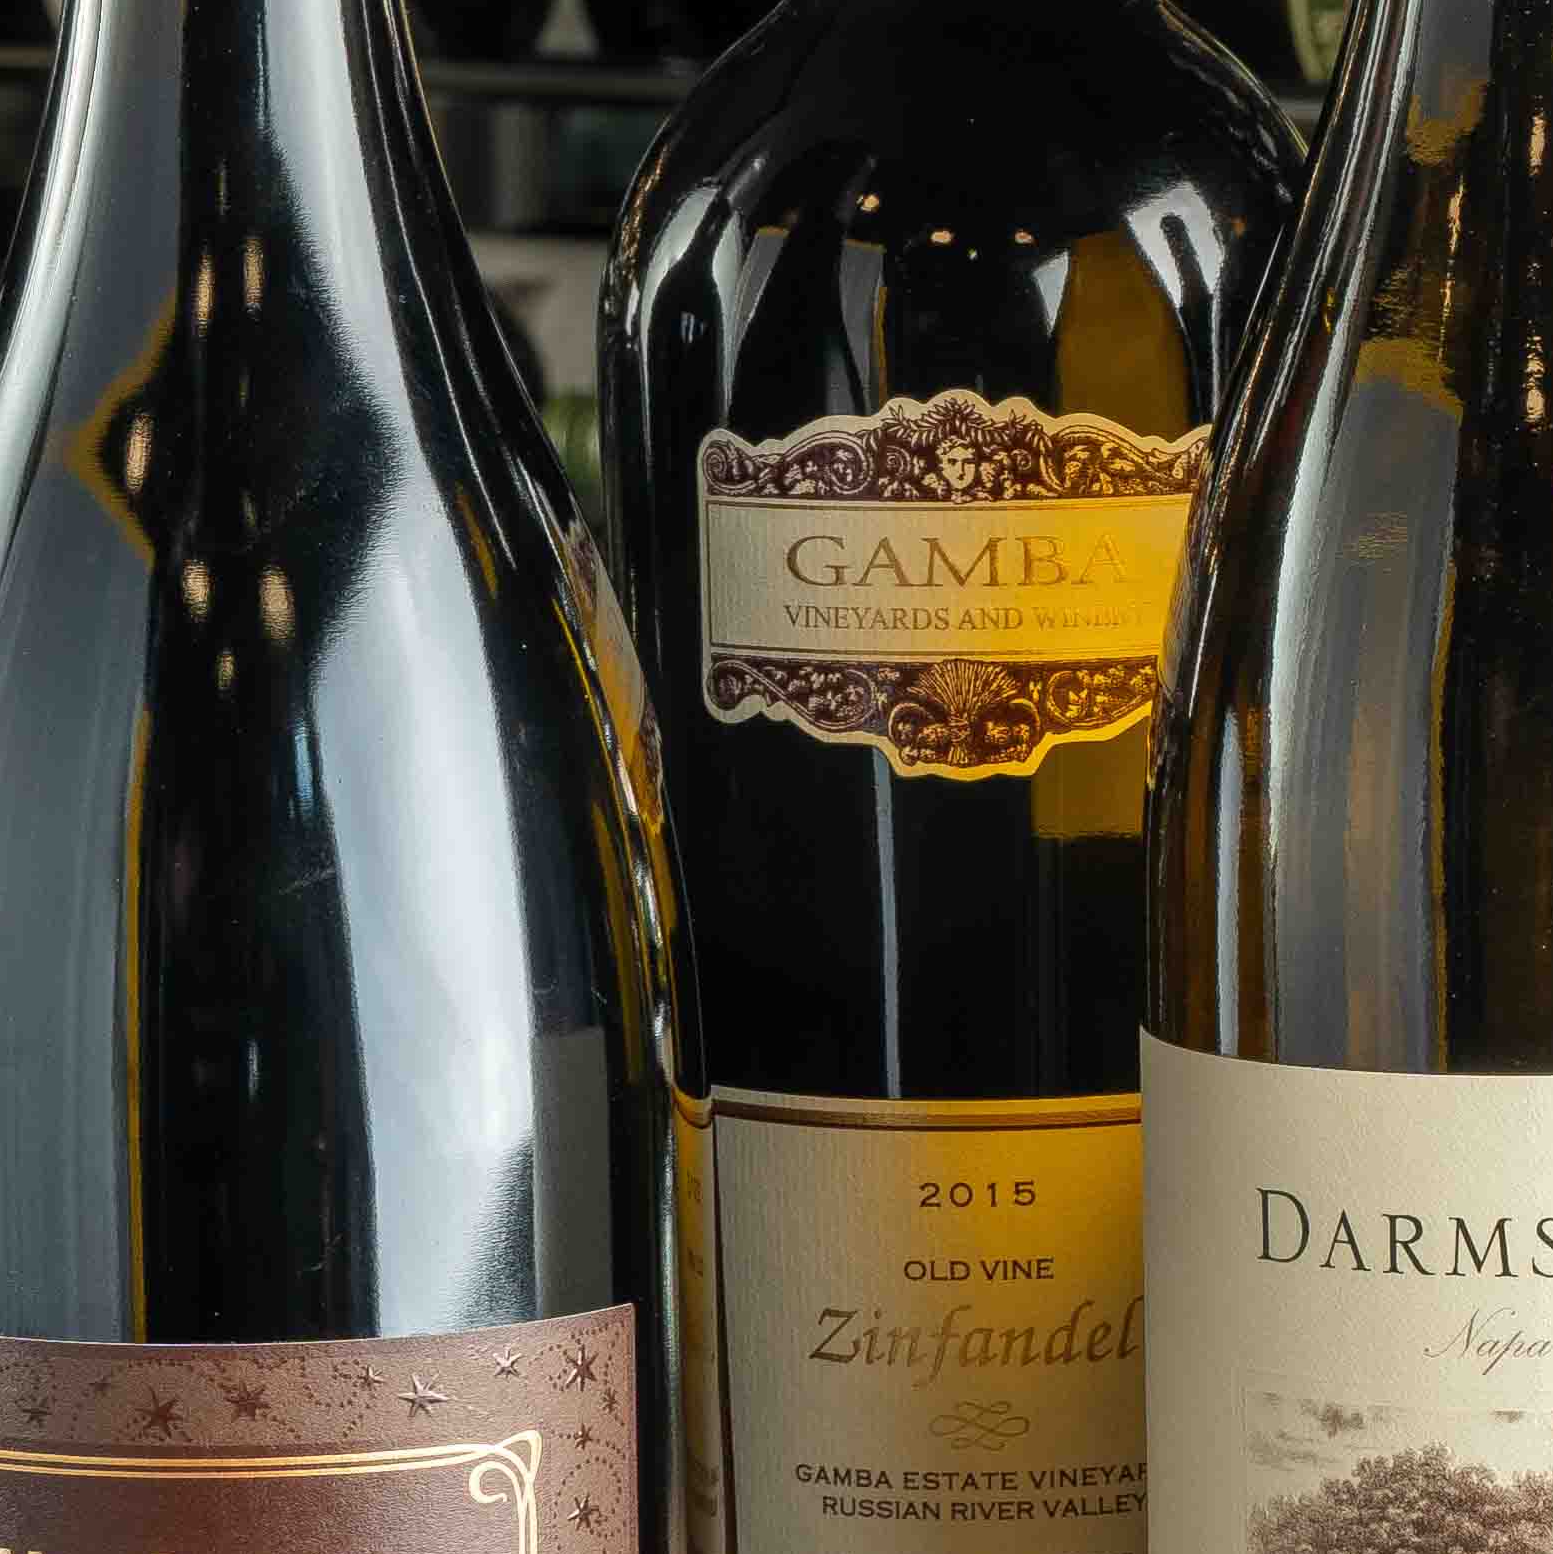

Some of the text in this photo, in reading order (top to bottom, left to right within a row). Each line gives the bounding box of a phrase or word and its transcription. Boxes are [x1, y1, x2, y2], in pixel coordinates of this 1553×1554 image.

[783, 534, 1131, 588] GAMBA
[782, 604, 949, 632] VINEYARDS
[958, 606, 1023, 632] AND
[918, 1179, 1037, 1208] 2015
[903, 1257, 1055, 1281] OLD VINE
[808, 1295, 1144, 1391] Zinfandel
[795, 1463, 893, 1490] GAMBA
[902, 1471, 1018, 1492] ESTATE
[822, 1493, 1146, 1521] RUSSIAN RIVER VALLEY
